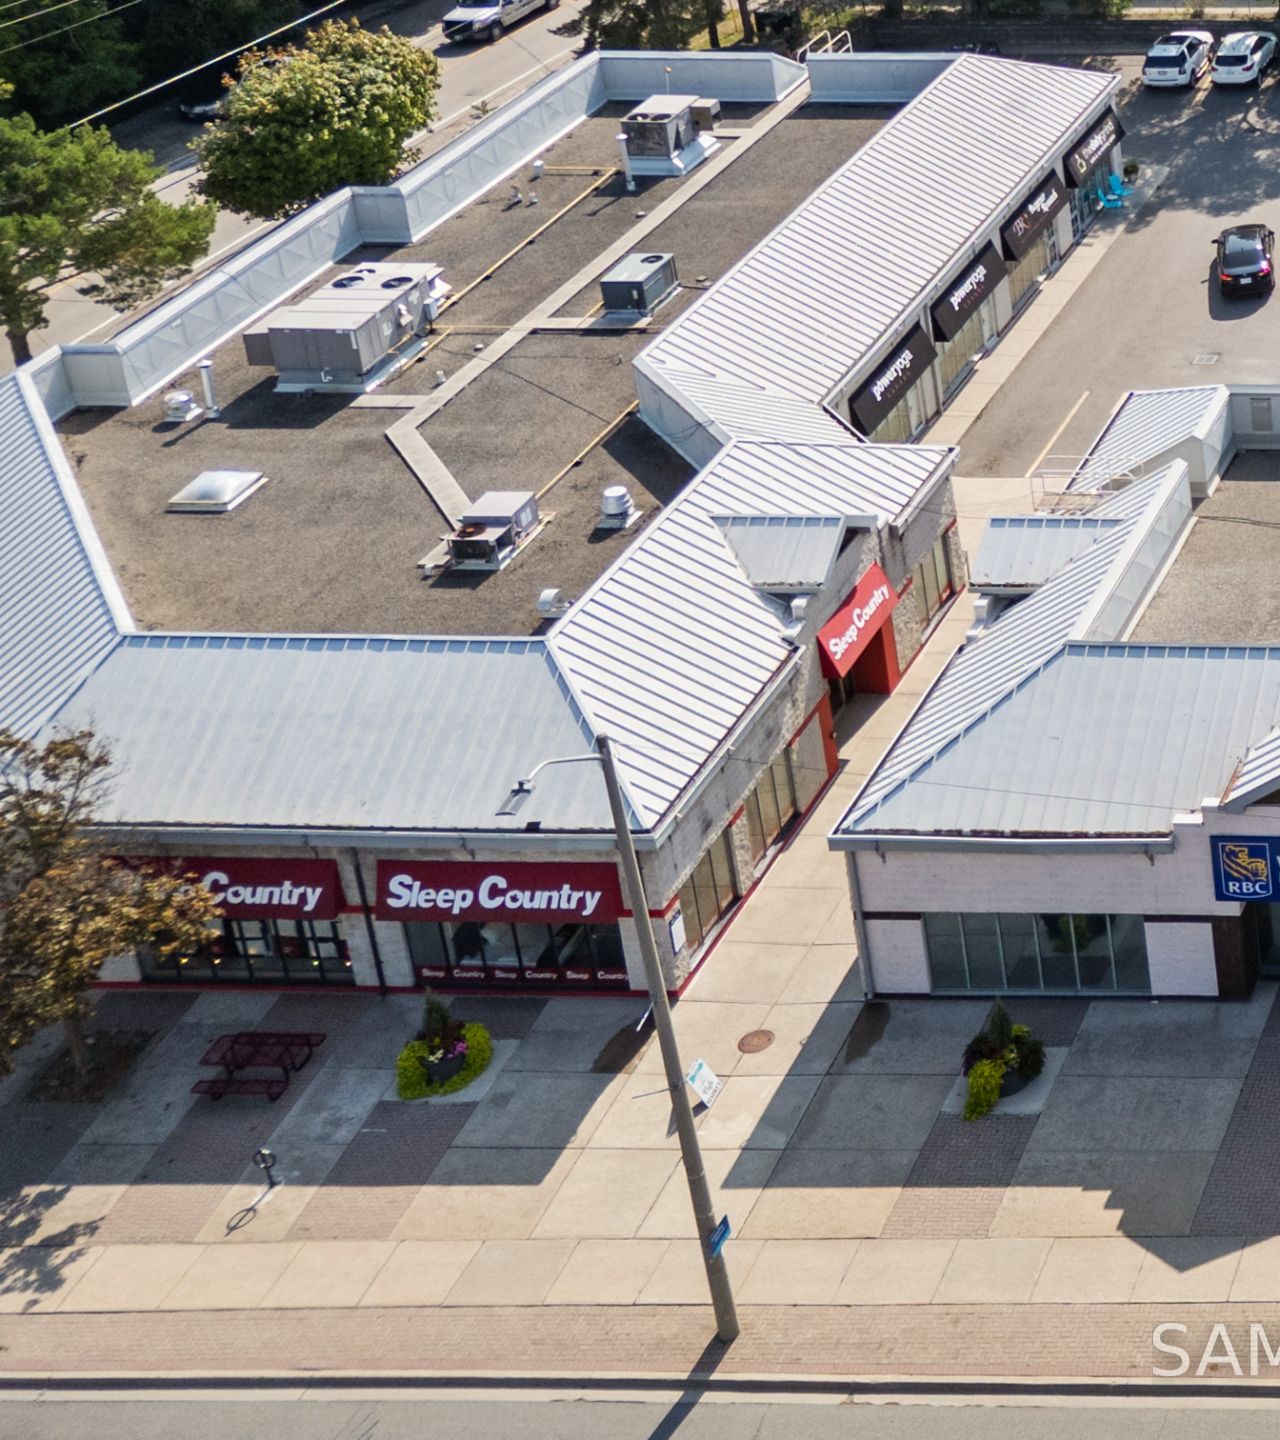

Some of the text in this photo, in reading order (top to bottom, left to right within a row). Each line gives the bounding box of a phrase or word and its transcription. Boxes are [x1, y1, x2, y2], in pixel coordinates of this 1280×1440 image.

[829, 584, 889, 660] Sleep Country
[202, 871, 323, 911] Country
[386, 874, 602, 916] Sleep Country
[1228, 881, 1268, 894] RBC
[422, 968, 628, 981] Sleep Country Sleep Country Sleep Country
